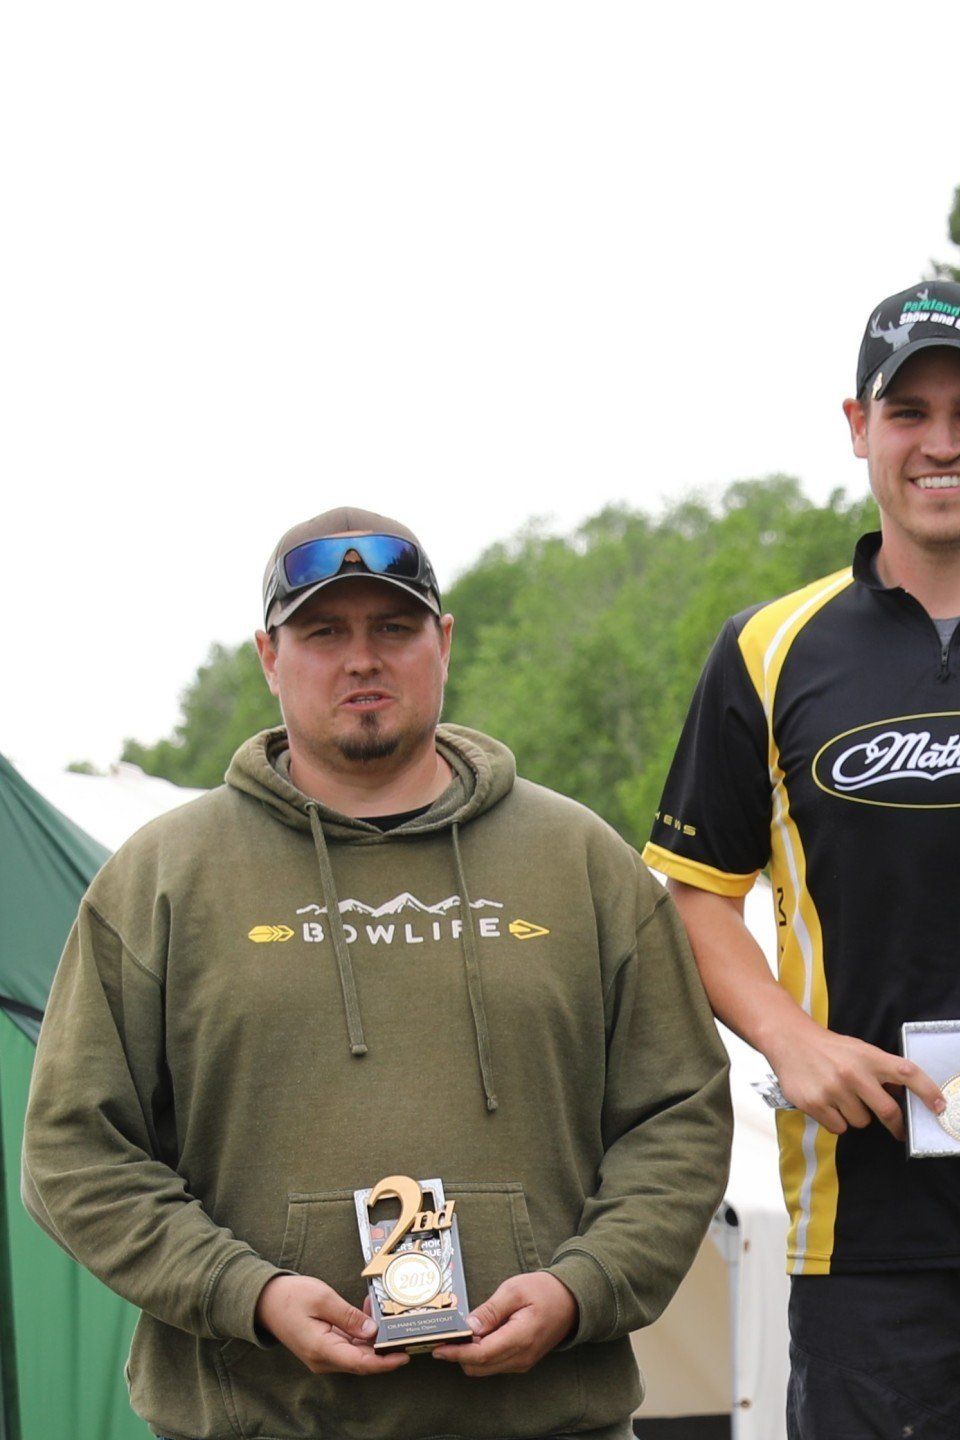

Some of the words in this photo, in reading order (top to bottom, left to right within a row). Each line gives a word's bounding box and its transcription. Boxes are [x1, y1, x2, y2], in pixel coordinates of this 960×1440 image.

[902, 299, 960, 317] Parkland
[899, 311, 931, 326] Show
[929, 312, 956, 327] and
[361, 1175, 456, 1277] 2nd
[401, 1272, 436, 1289] 2019
